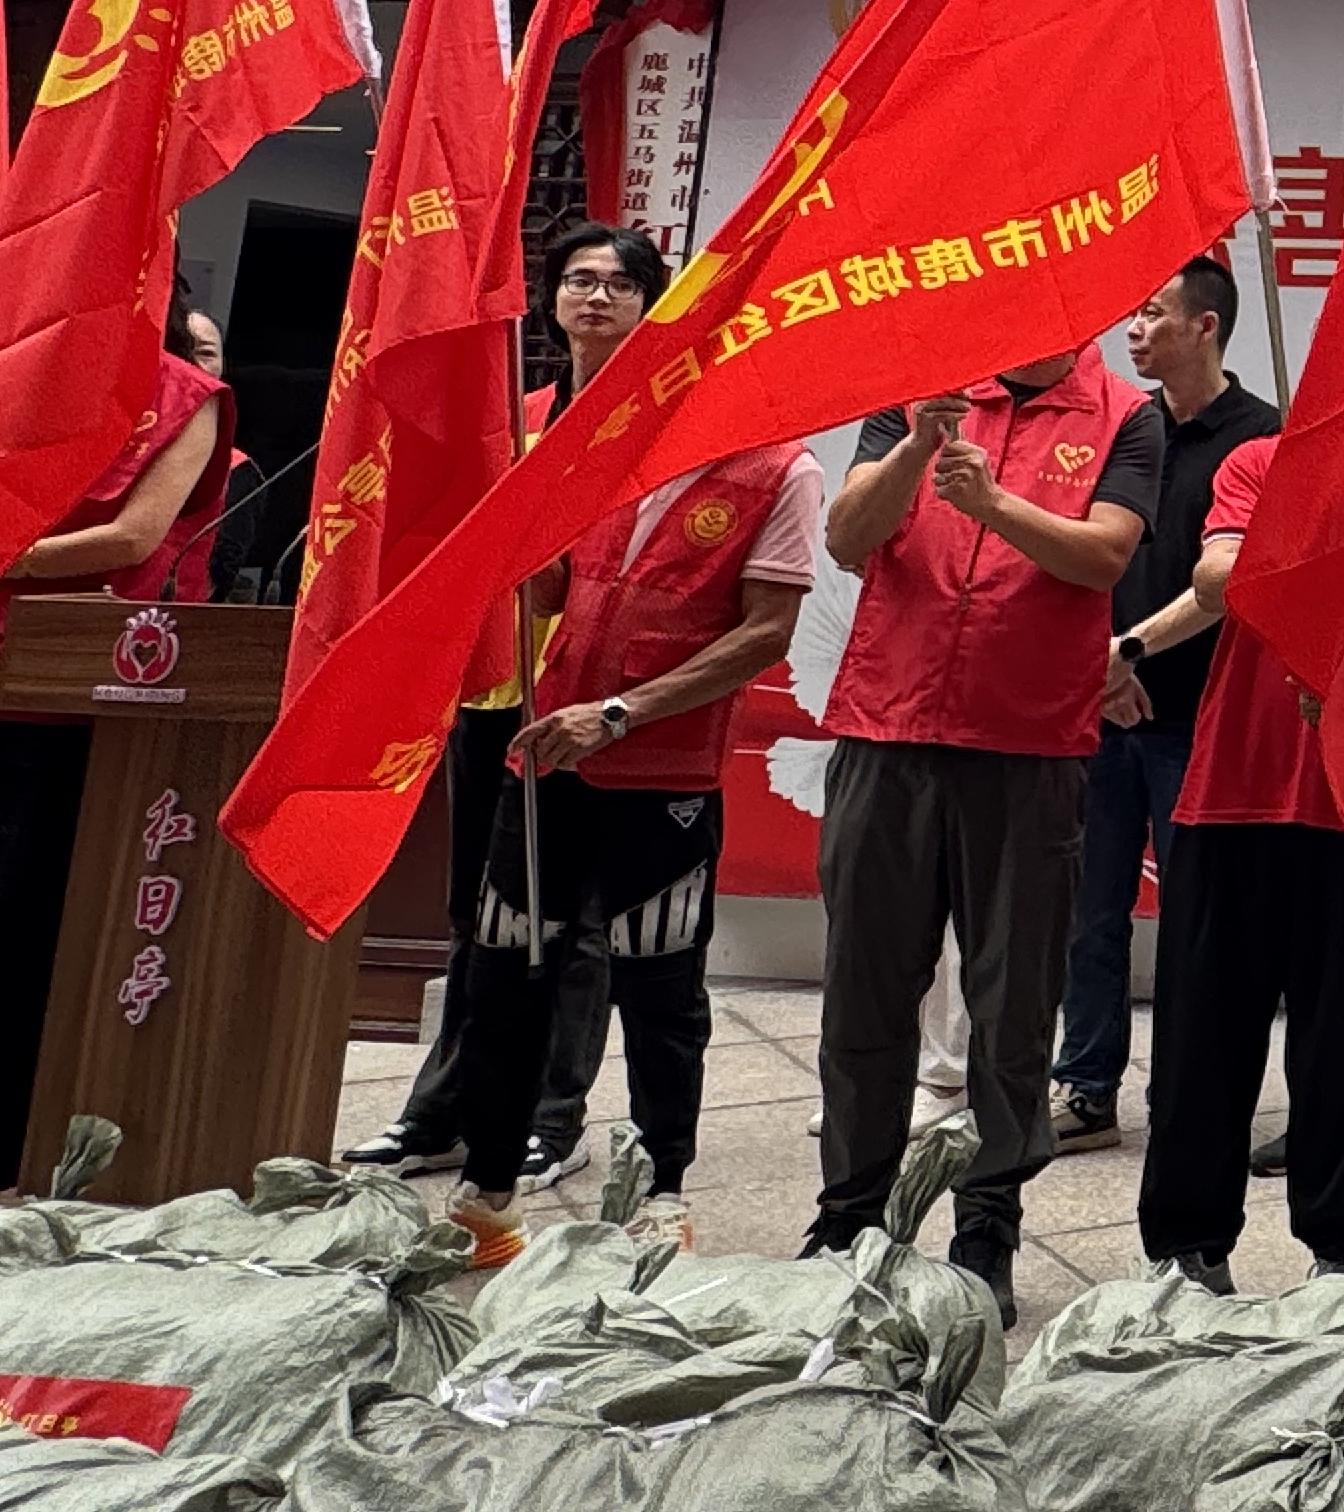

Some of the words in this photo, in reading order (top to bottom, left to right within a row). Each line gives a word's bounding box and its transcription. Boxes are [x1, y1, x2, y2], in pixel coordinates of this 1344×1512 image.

[621, 52, 669, 212] 鹿城区五马街道
[118, 788, 196, 1025] 红日亭
